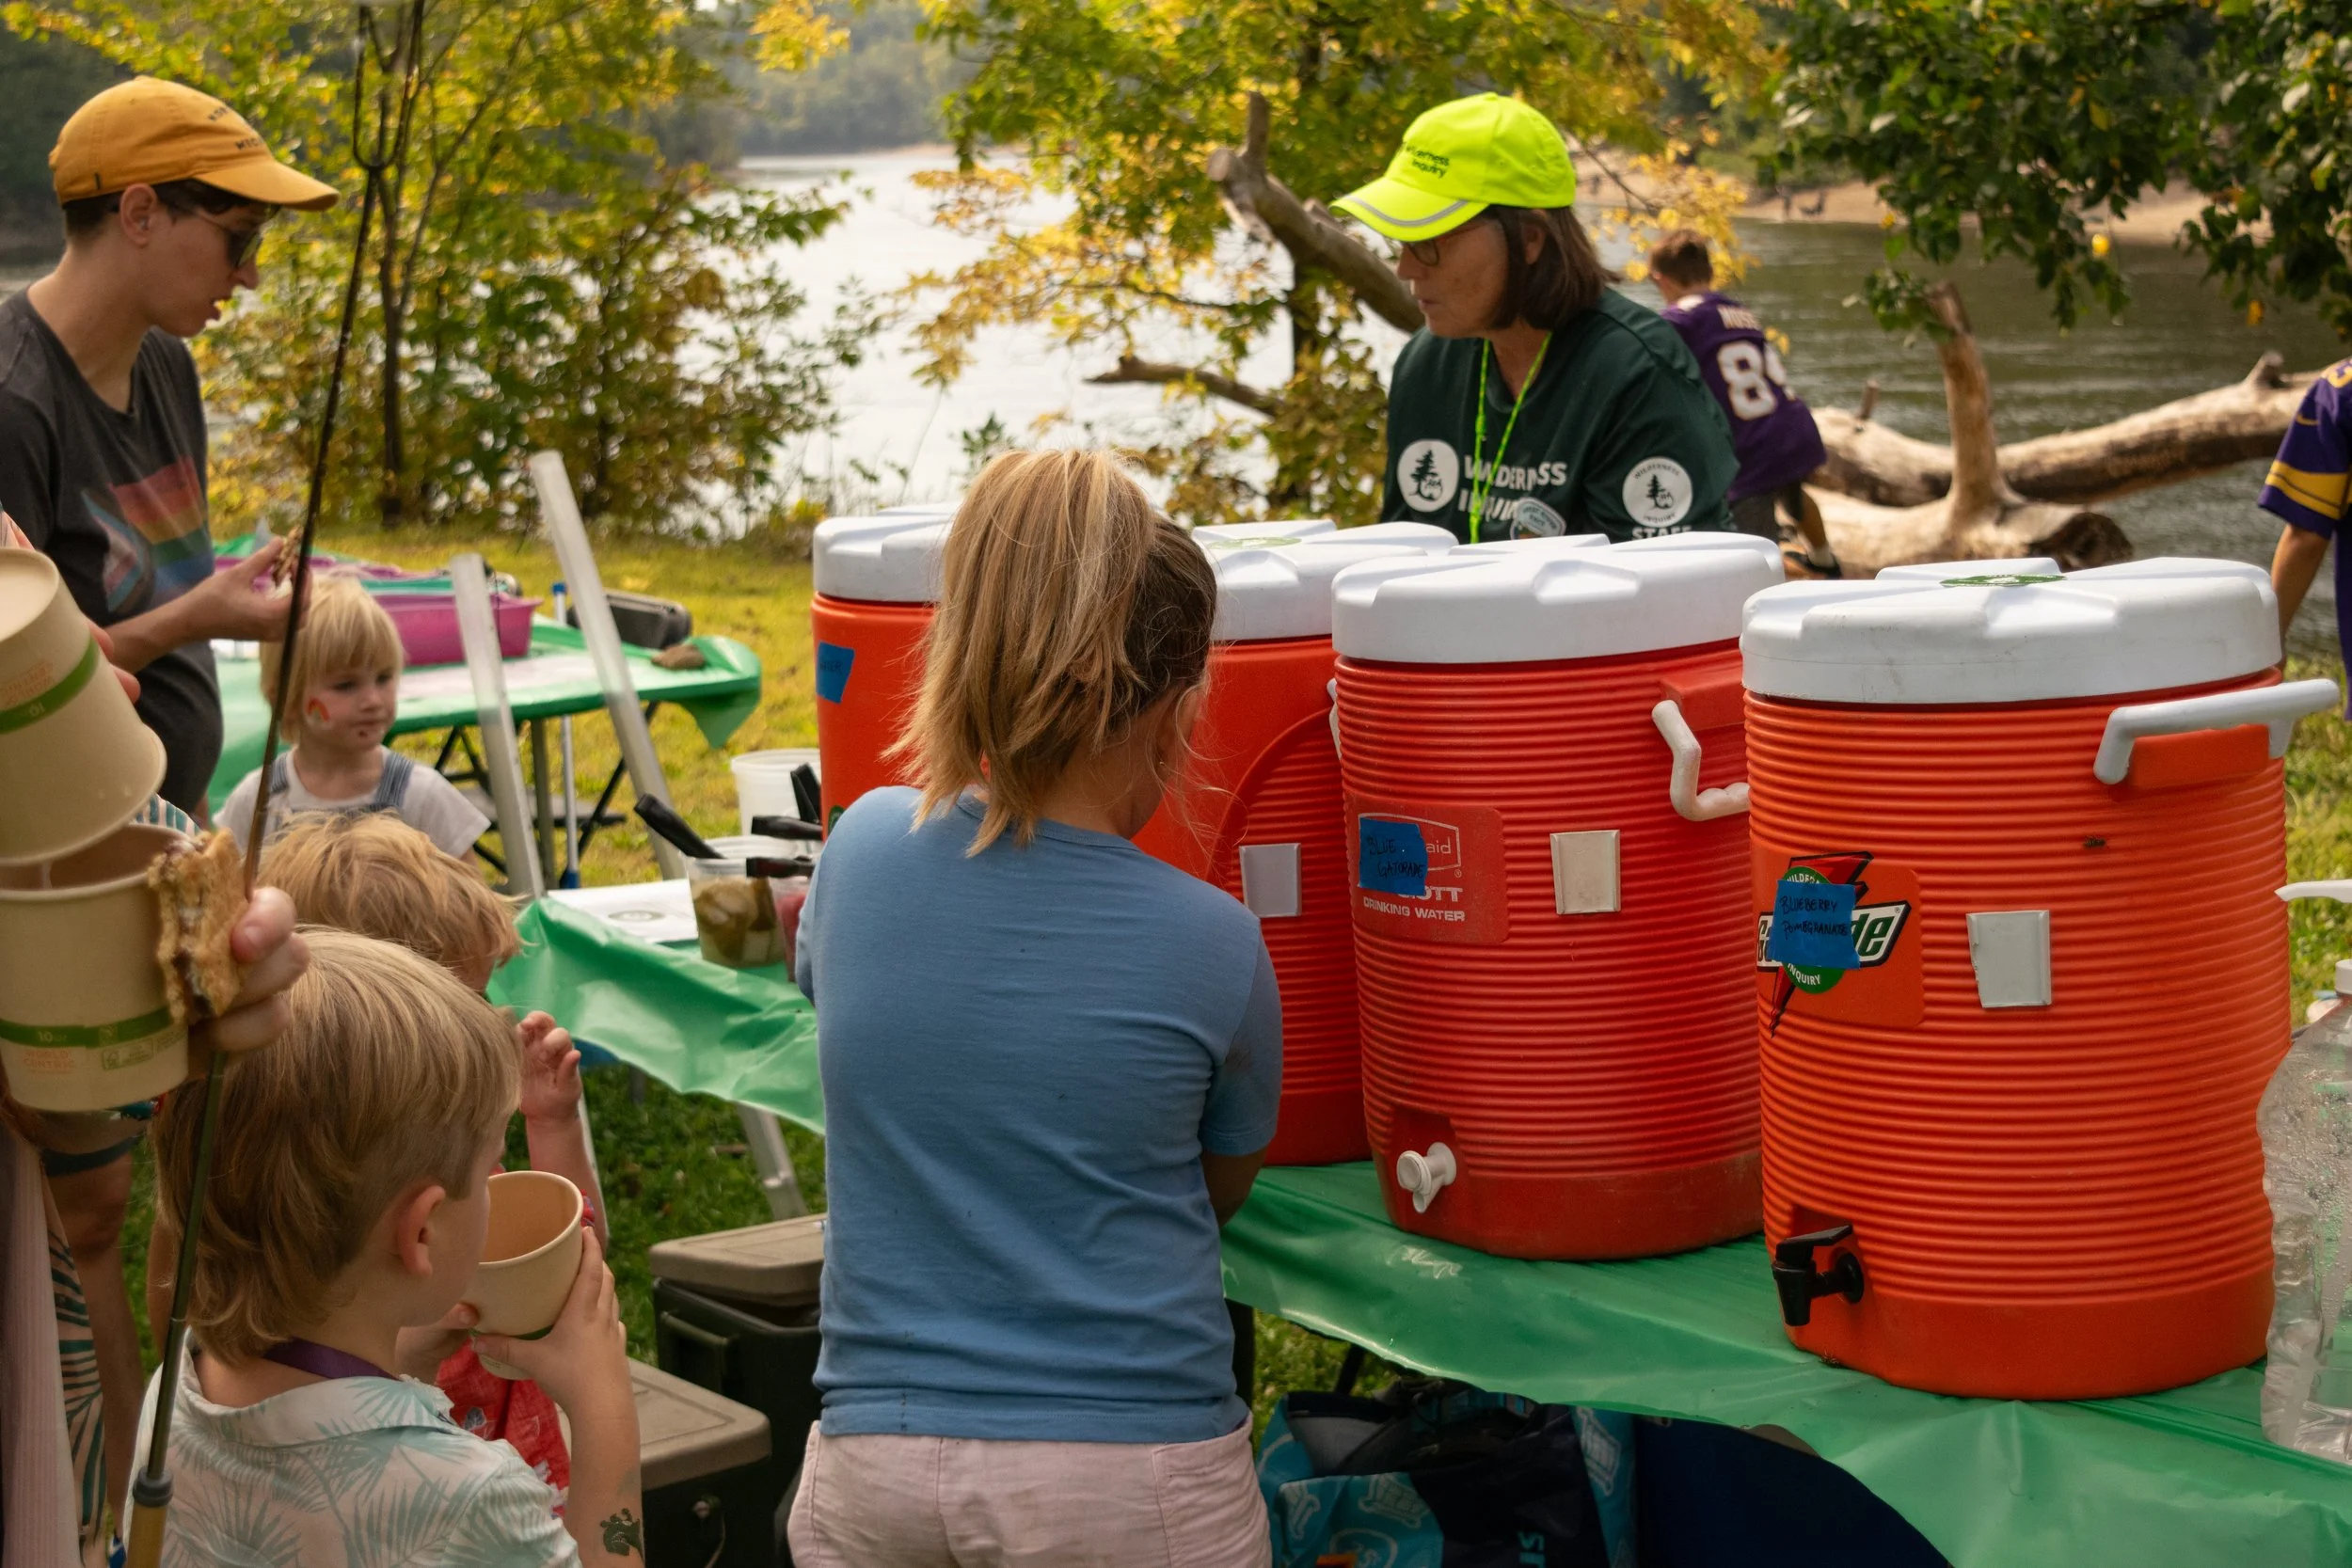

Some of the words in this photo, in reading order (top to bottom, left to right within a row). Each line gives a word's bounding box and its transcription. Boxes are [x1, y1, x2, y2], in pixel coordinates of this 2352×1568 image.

[1367, 835, 1396, 855] BLUE
[1398, 884, 1463, 902] OTT
[1363, 895, 1411, 917] DRINKING
[1414, 907, 1466, 922] WATER
[1780, 895, 1837, 915] BLUEBERRY
